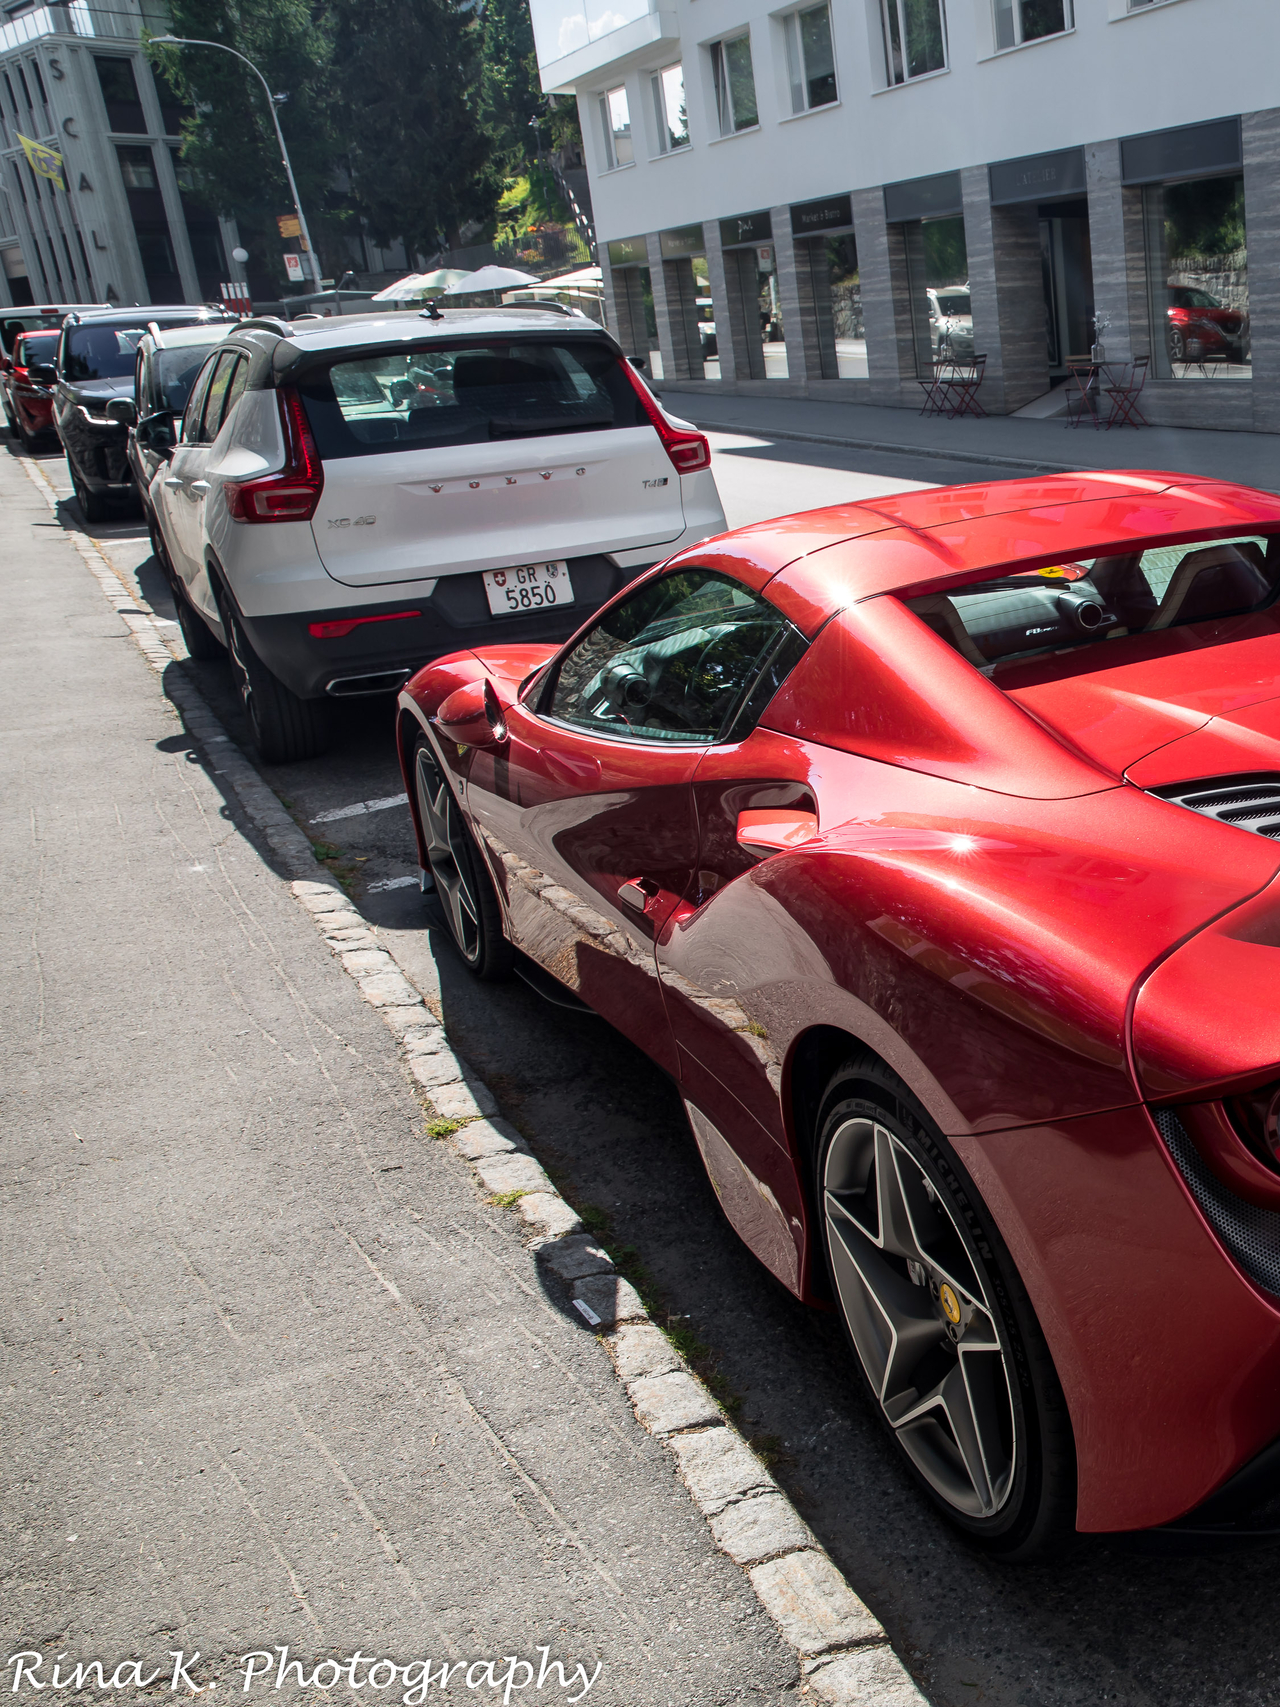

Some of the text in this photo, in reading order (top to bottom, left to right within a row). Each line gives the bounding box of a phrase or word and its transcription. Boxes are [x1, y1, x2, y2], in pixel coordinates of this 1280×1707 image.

[49, 58, 120, 303] SCALA
[801, 212, 819, 224] Market
[825, 209, 841, 219] Bistro
[428, 466, 587, 494] VOLVO
[516, 566, 538, 584] GR
[505, 584, 556, 610] 5850
[917, 1128, 994, 1261] MICHELIN
